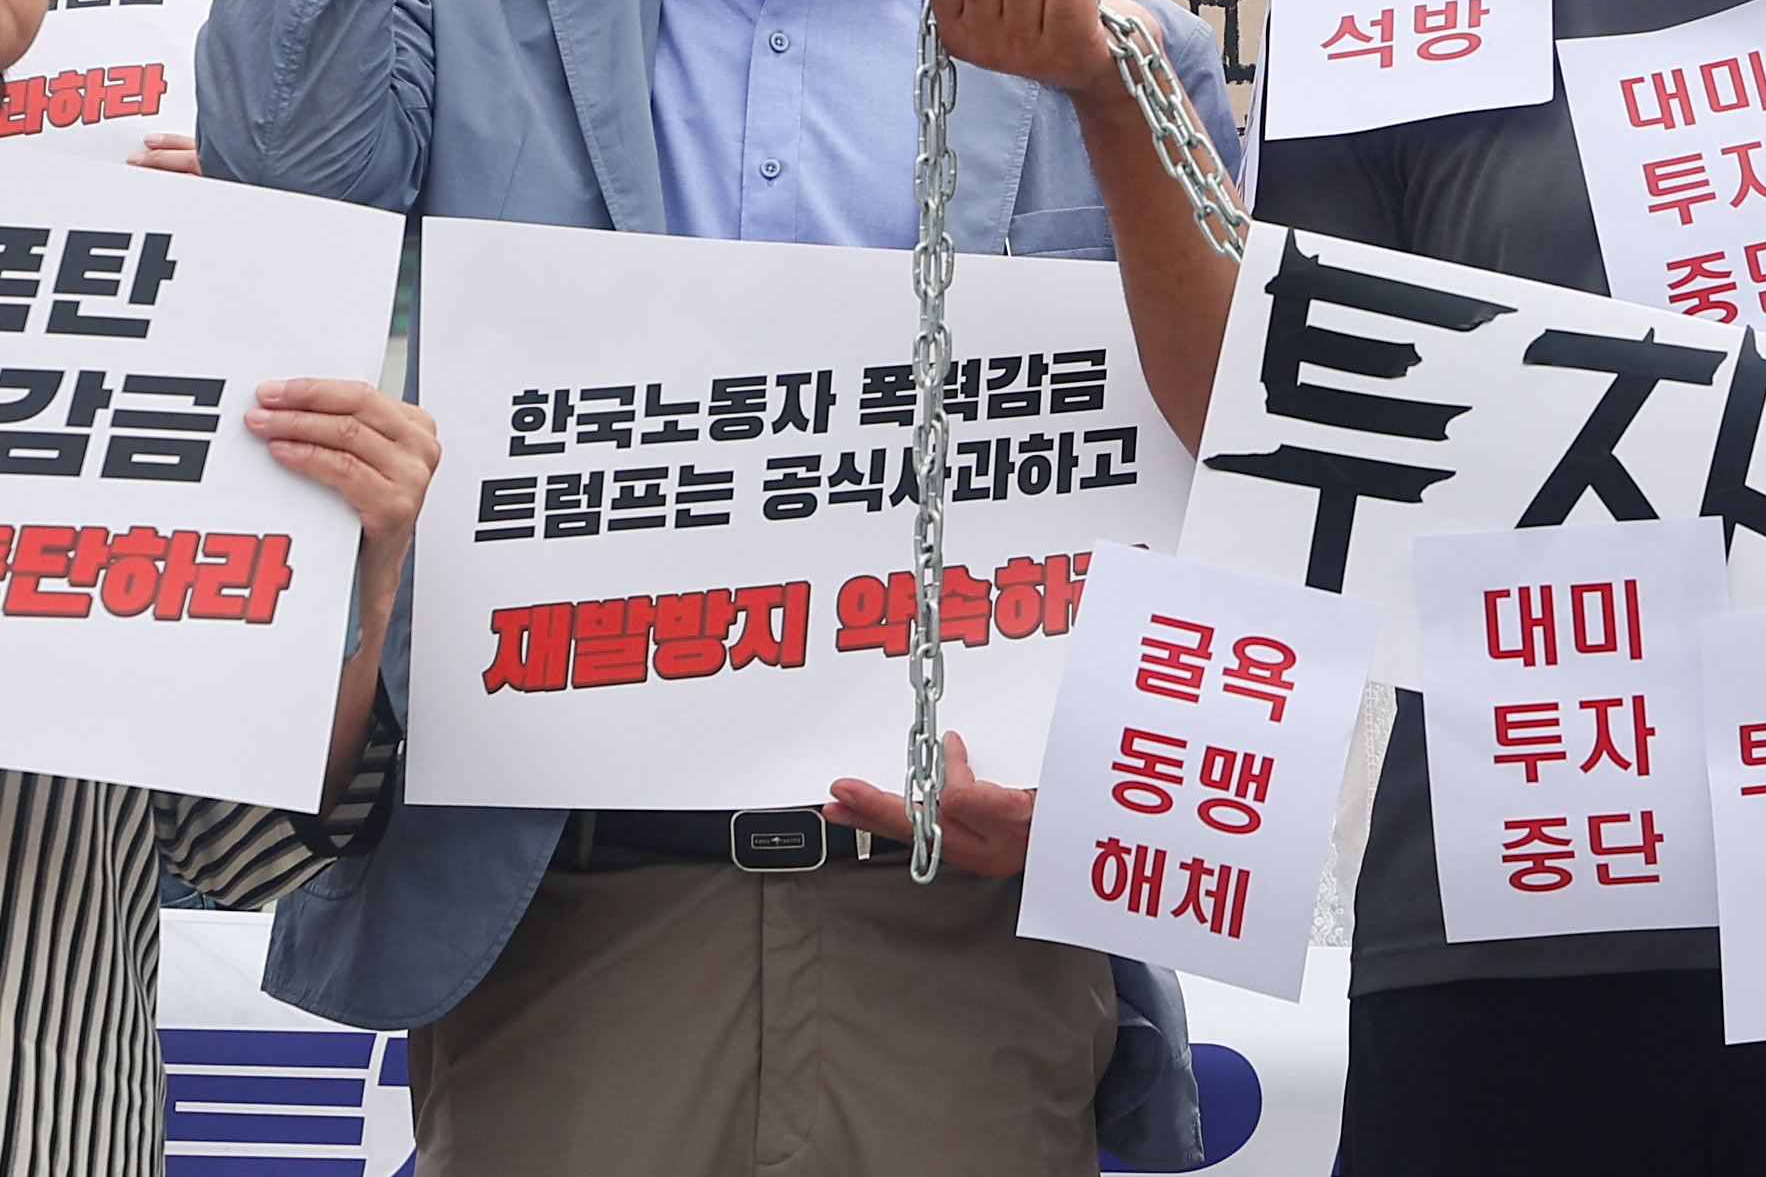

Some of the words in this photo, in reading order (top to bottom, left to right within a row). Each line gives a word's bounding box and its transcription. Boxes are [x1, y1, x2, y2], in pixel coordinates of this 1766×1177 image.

[507, 369, 837, 458] 한국노동자
[473, 465, 735, 543] 트럼프는
[0, 525, 293, 624] 단하라
[482, 581, 811, 695] 재발방지
[835, 544, 1149, 658] 약속하
[1135, 613, 1298, 724] 굴욕
[1483, 579, 1643, 668] 대미
[1111, 727, 1275, 836] 동맹
[1493, 695, 1656, 784] 투자
[1091, 836, 1251, 940] 해체
[1501, 810, 1665, 893] 중단
